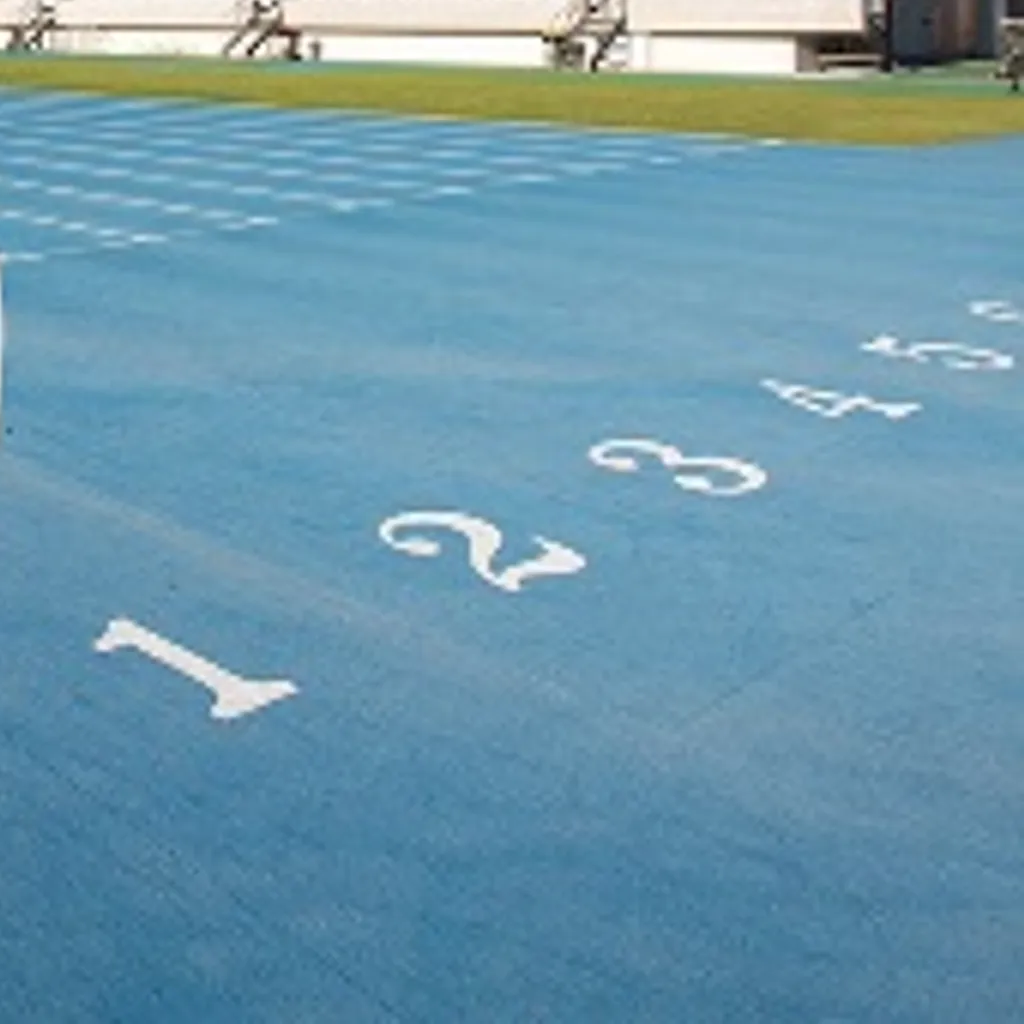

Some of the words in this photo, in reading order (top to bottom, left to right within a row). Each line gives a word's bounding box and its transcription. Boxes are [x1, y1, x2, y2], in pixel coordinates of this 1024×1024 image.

[860, 335, 1014, 370] 5
[761, 378, 921, 419] 4
[588, 437, 767, 497] 3
[379, 510, 586, 592] 2
[94, 618, 298, 719] 1
